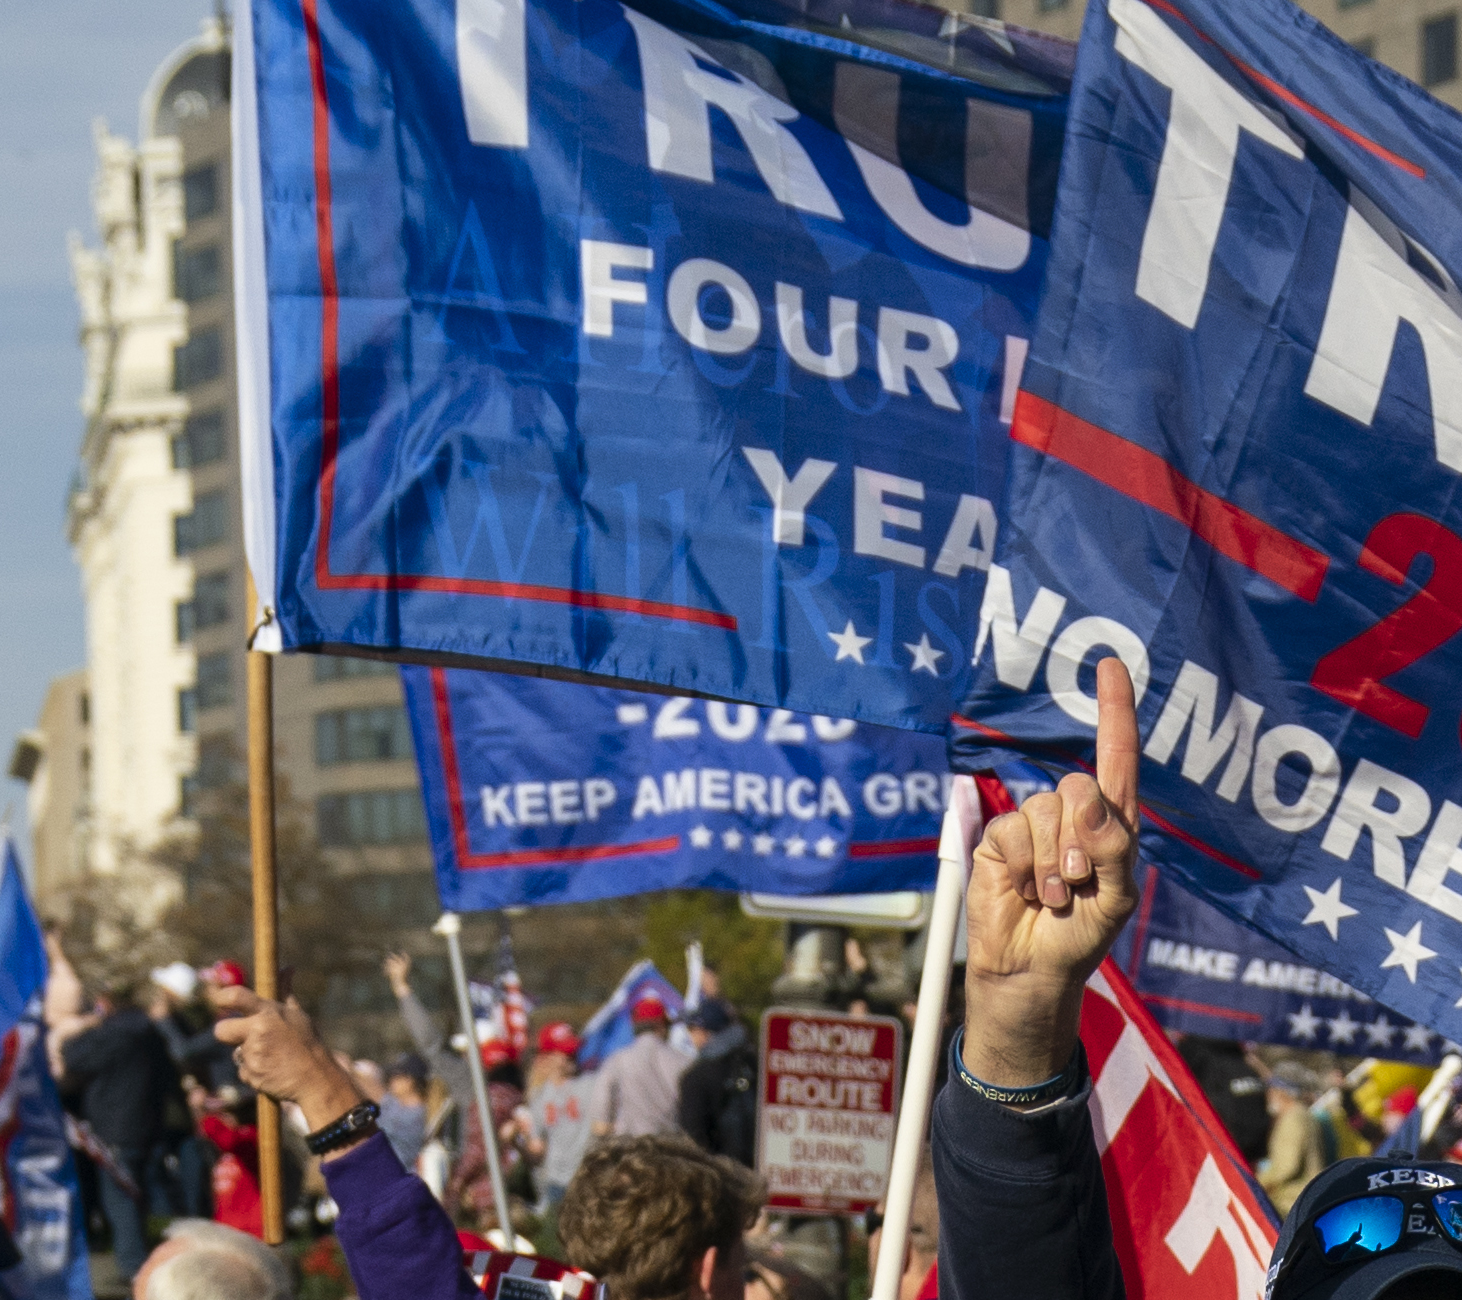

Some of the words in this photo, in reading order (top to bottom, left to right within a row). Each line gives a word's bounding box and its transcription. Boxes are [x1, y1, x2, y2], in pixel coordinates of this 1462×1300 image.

[580, 239, 962, 411] FOUR
[742, 446, 999, 577] YEA
[973, 565, 1150, 727] NO
[480, 777, 617, 829] KEEP
[631, 767, 852, 820] AMERICA
[1146, 937, 1240, 981] MAKE
[788, 1020, 878, 1056] SNOW
[776, 1075, 884, 1110] ROUTE
